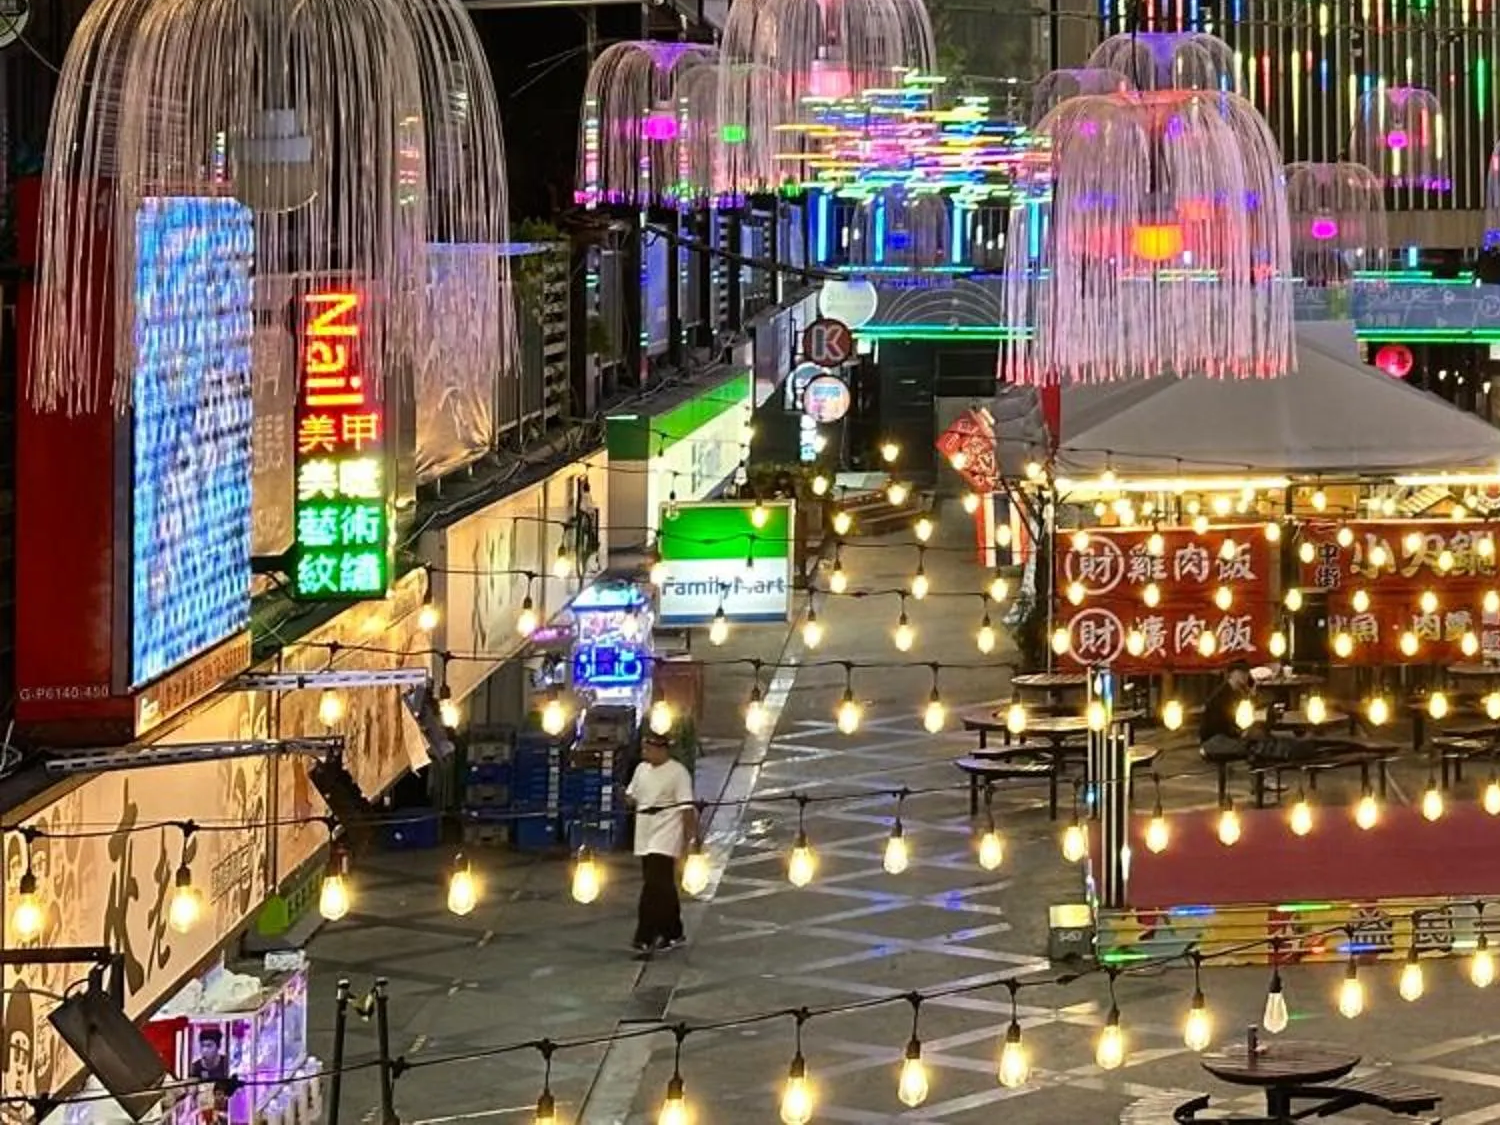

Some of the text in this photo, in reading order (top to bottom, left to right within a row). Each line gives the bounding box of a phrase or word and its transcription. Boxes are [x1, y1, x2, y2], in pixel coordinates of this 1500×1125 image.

[306, 293, 364, 405] Nail
[298, 413, 380, 453] 美甲
[298, 506, 381, 547] 藝術
